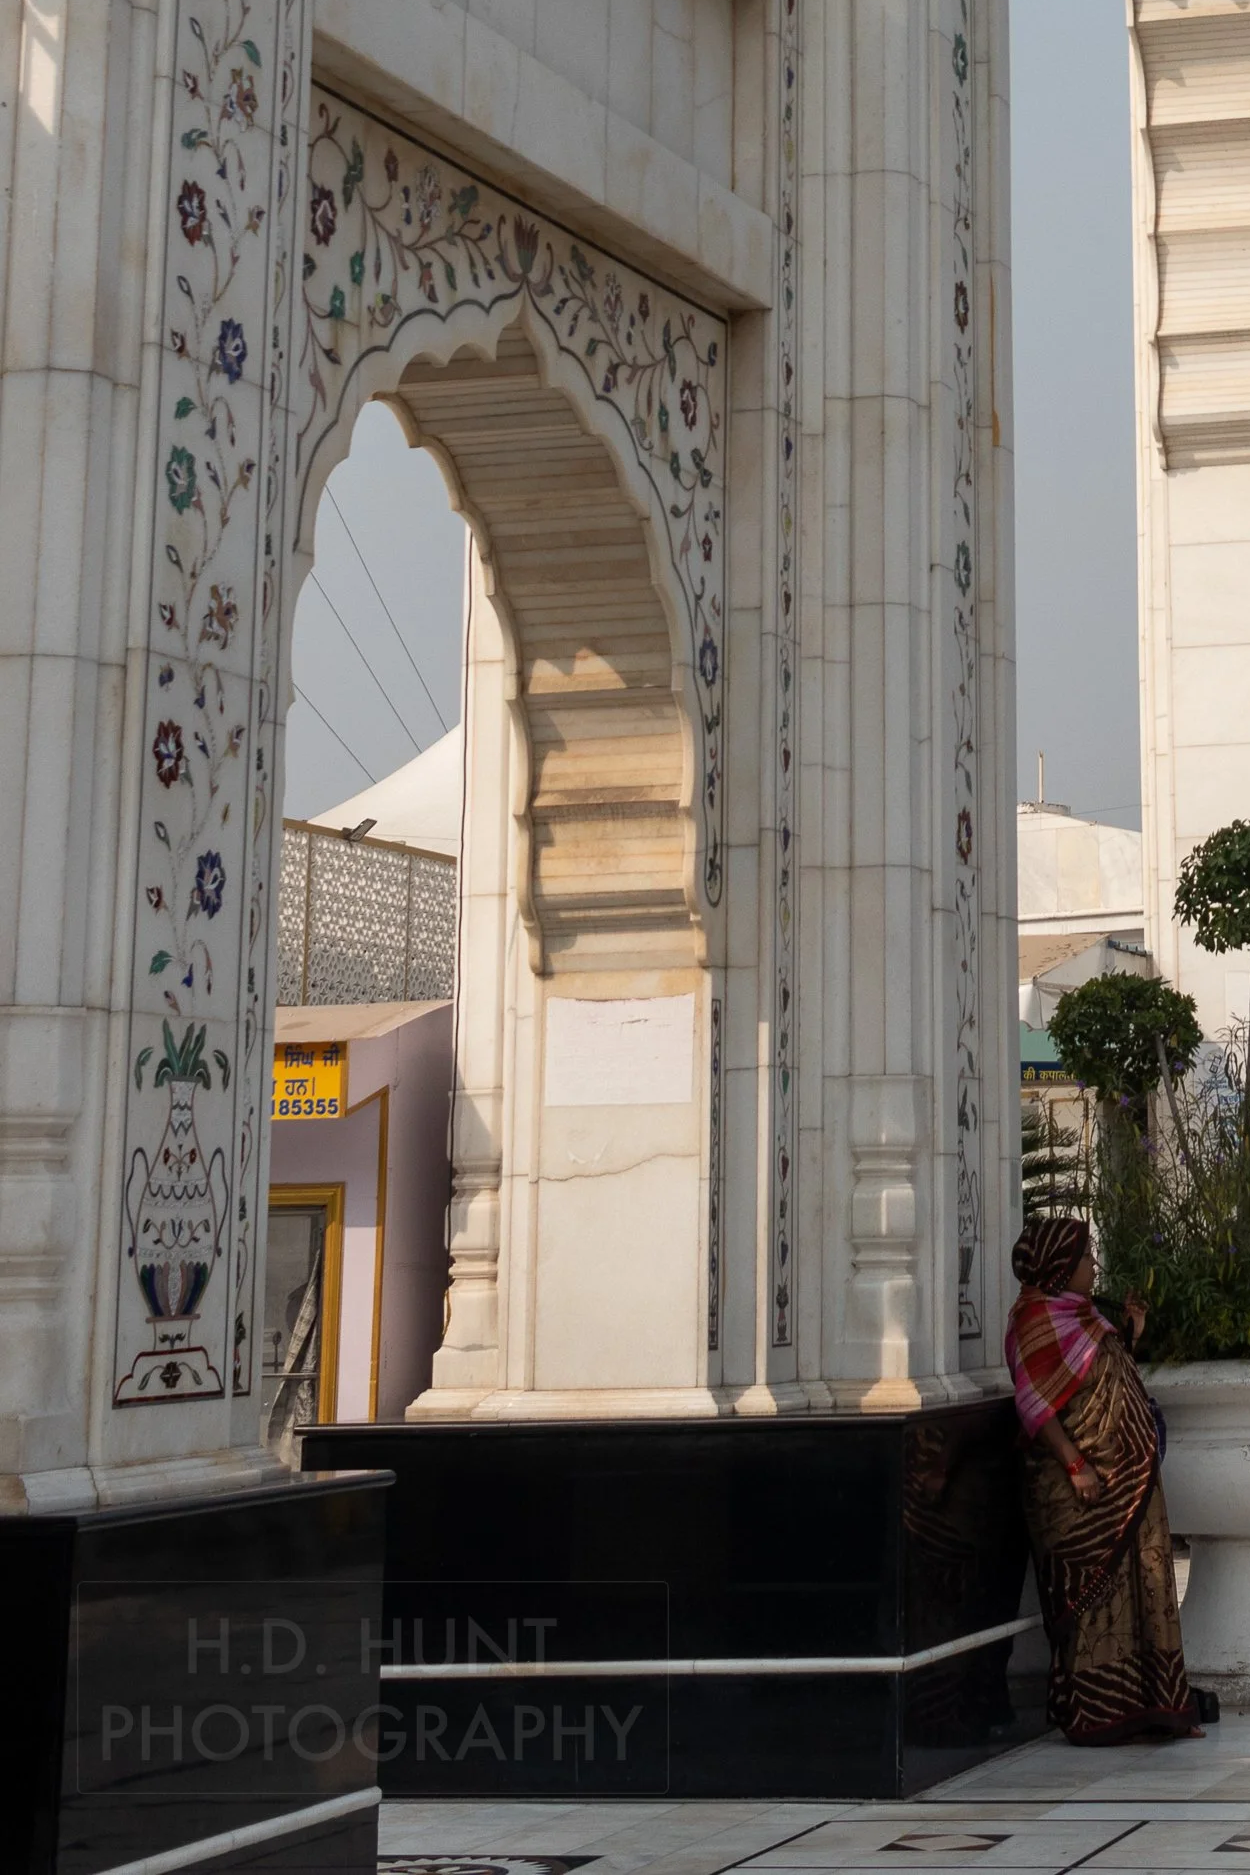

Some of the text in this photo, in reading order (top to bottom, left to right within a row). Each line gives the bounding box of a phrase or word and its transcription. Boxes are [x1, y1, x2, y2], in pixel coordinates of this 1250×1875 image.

[284, 1043, 339, 1068] ਸਿੰਘ ਜੀ
[1023, 1066, 1036, 1081] की
